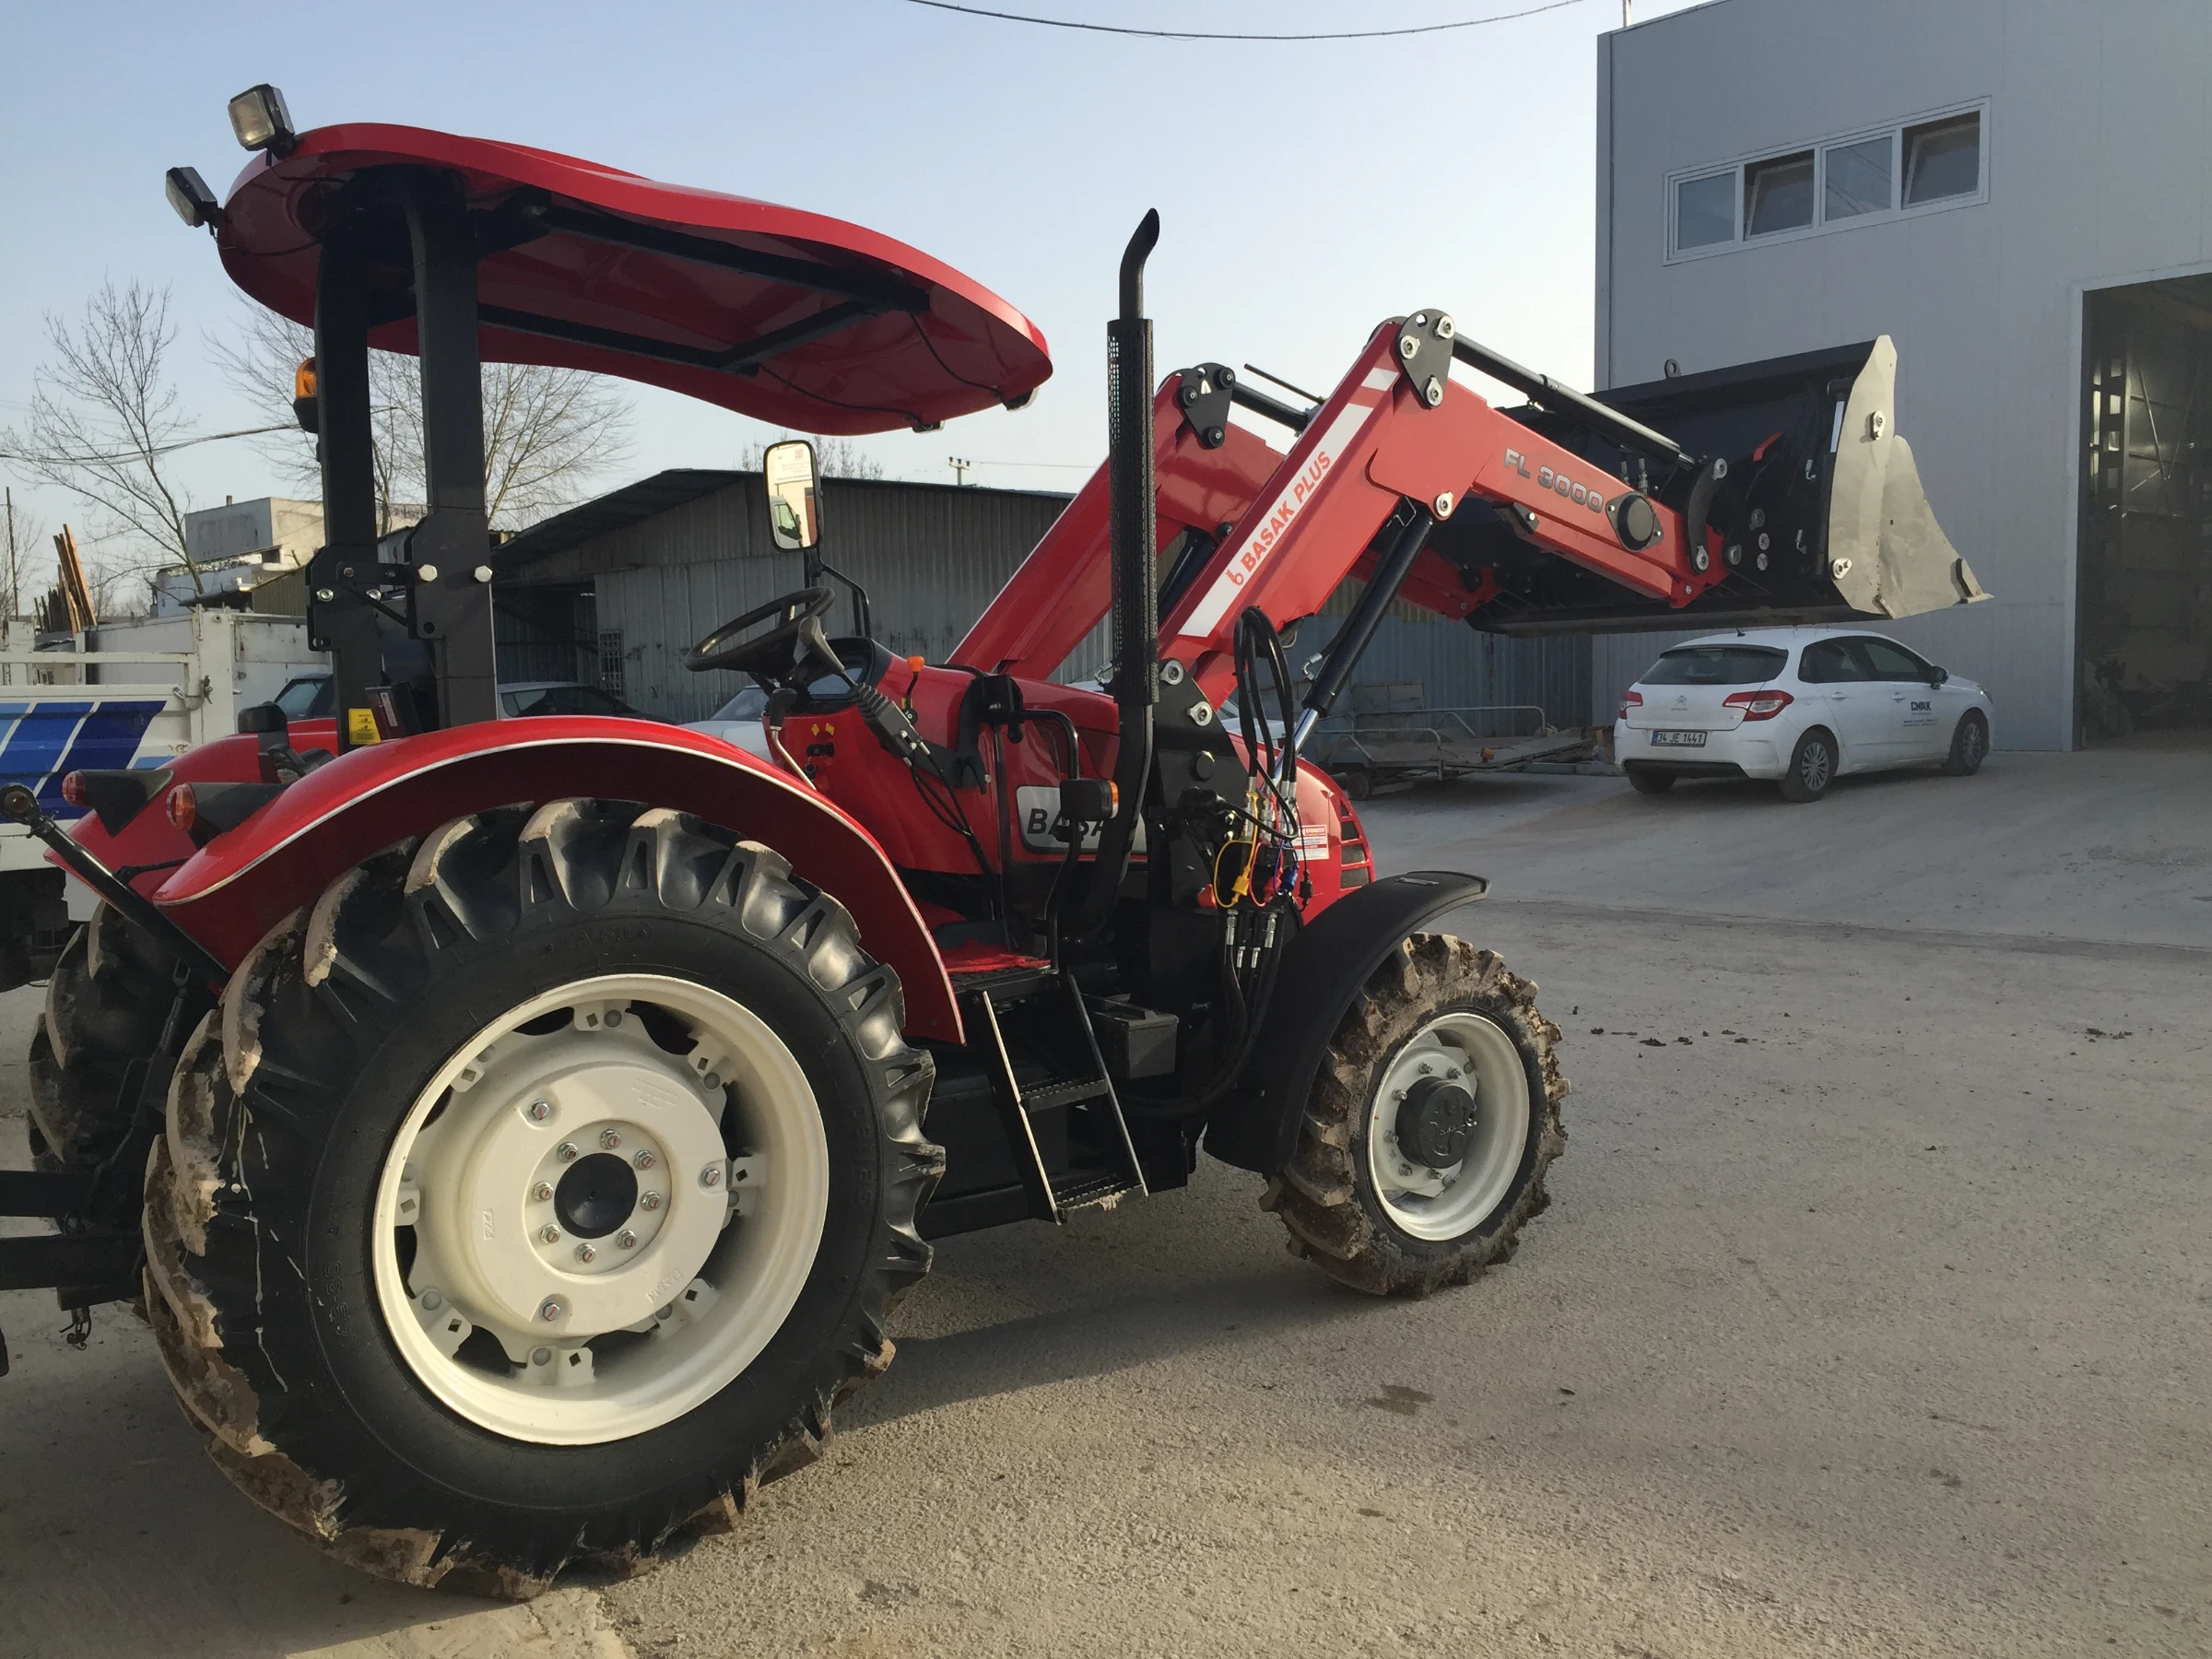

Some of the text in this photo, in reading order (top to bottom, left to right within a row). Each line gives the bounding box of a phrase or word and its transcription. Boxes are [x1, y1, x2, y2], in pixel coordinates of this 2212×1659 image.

[1241, 500, 1295, 572] BASAK
[1293, 451, 1331, 503] PLUS
[1504, 448, 1604, 513] FL 3000
[1657, 733, 1703, 743] 34 JE 1441
